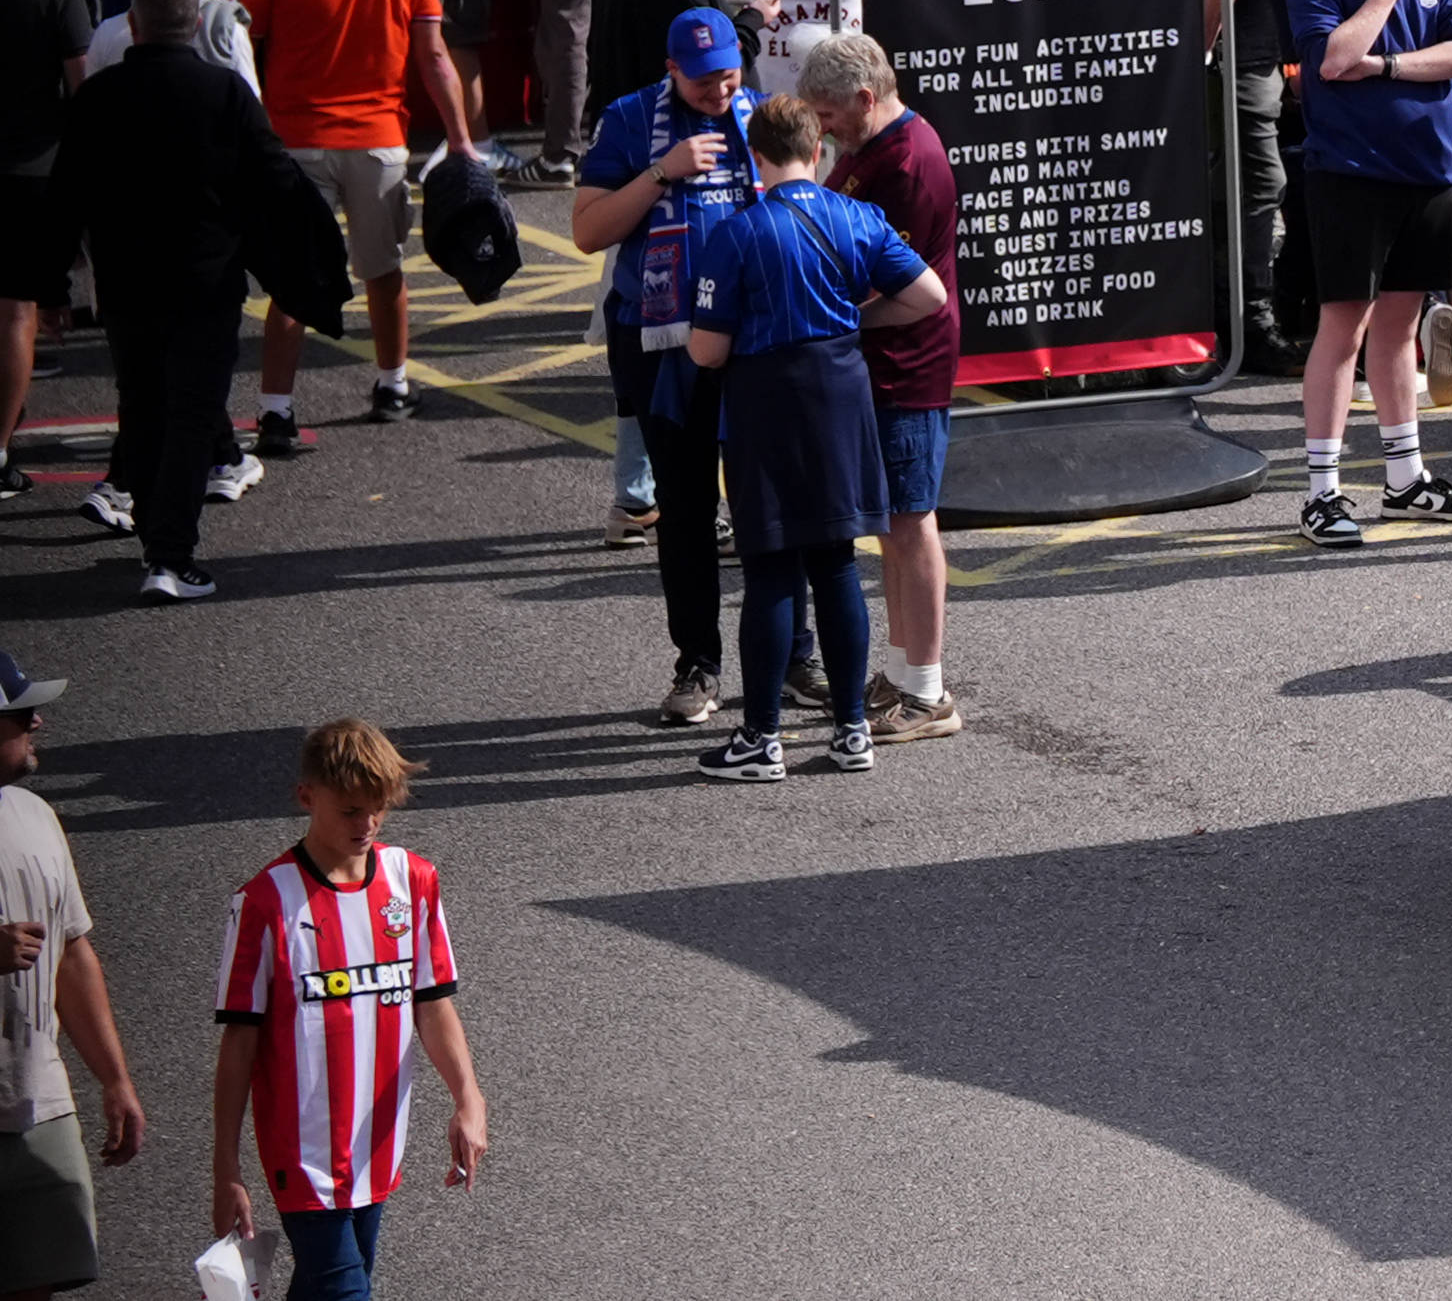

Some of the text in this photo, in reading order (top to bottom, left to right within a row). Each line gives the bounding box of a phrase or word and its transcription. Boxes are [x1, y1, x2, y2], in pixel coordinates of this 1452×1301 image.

[893, 28, 1180, 71] ENJOY FUN ACTIVITIES
[918, 54, 1158, 93] FOR ALL THE FAMILY
[973, 85, 1104, 114] INCLUDING
[947, 127, 1169, 166] CTURES WITH SAMMY
[989, 159, 1094, 185] AND MARY
[701, 188, 747, 205] TOUR
[961, 178, 1131, 212] FACE PAINTING
[956, 200, 1151, 236] AMES AND PRIZES
[994, 232, 1058, 256] GUEST
[1068, 218, 1204, 249] INTERVIEWS
[1000, 253, 1096, 281] QUIZZES
[963, 270, 1156, 306] VARIETY OF FOOD
[986, 299, 1105, 328] AND DRINK
[304, 961, 413, 999] ROLLBIT
